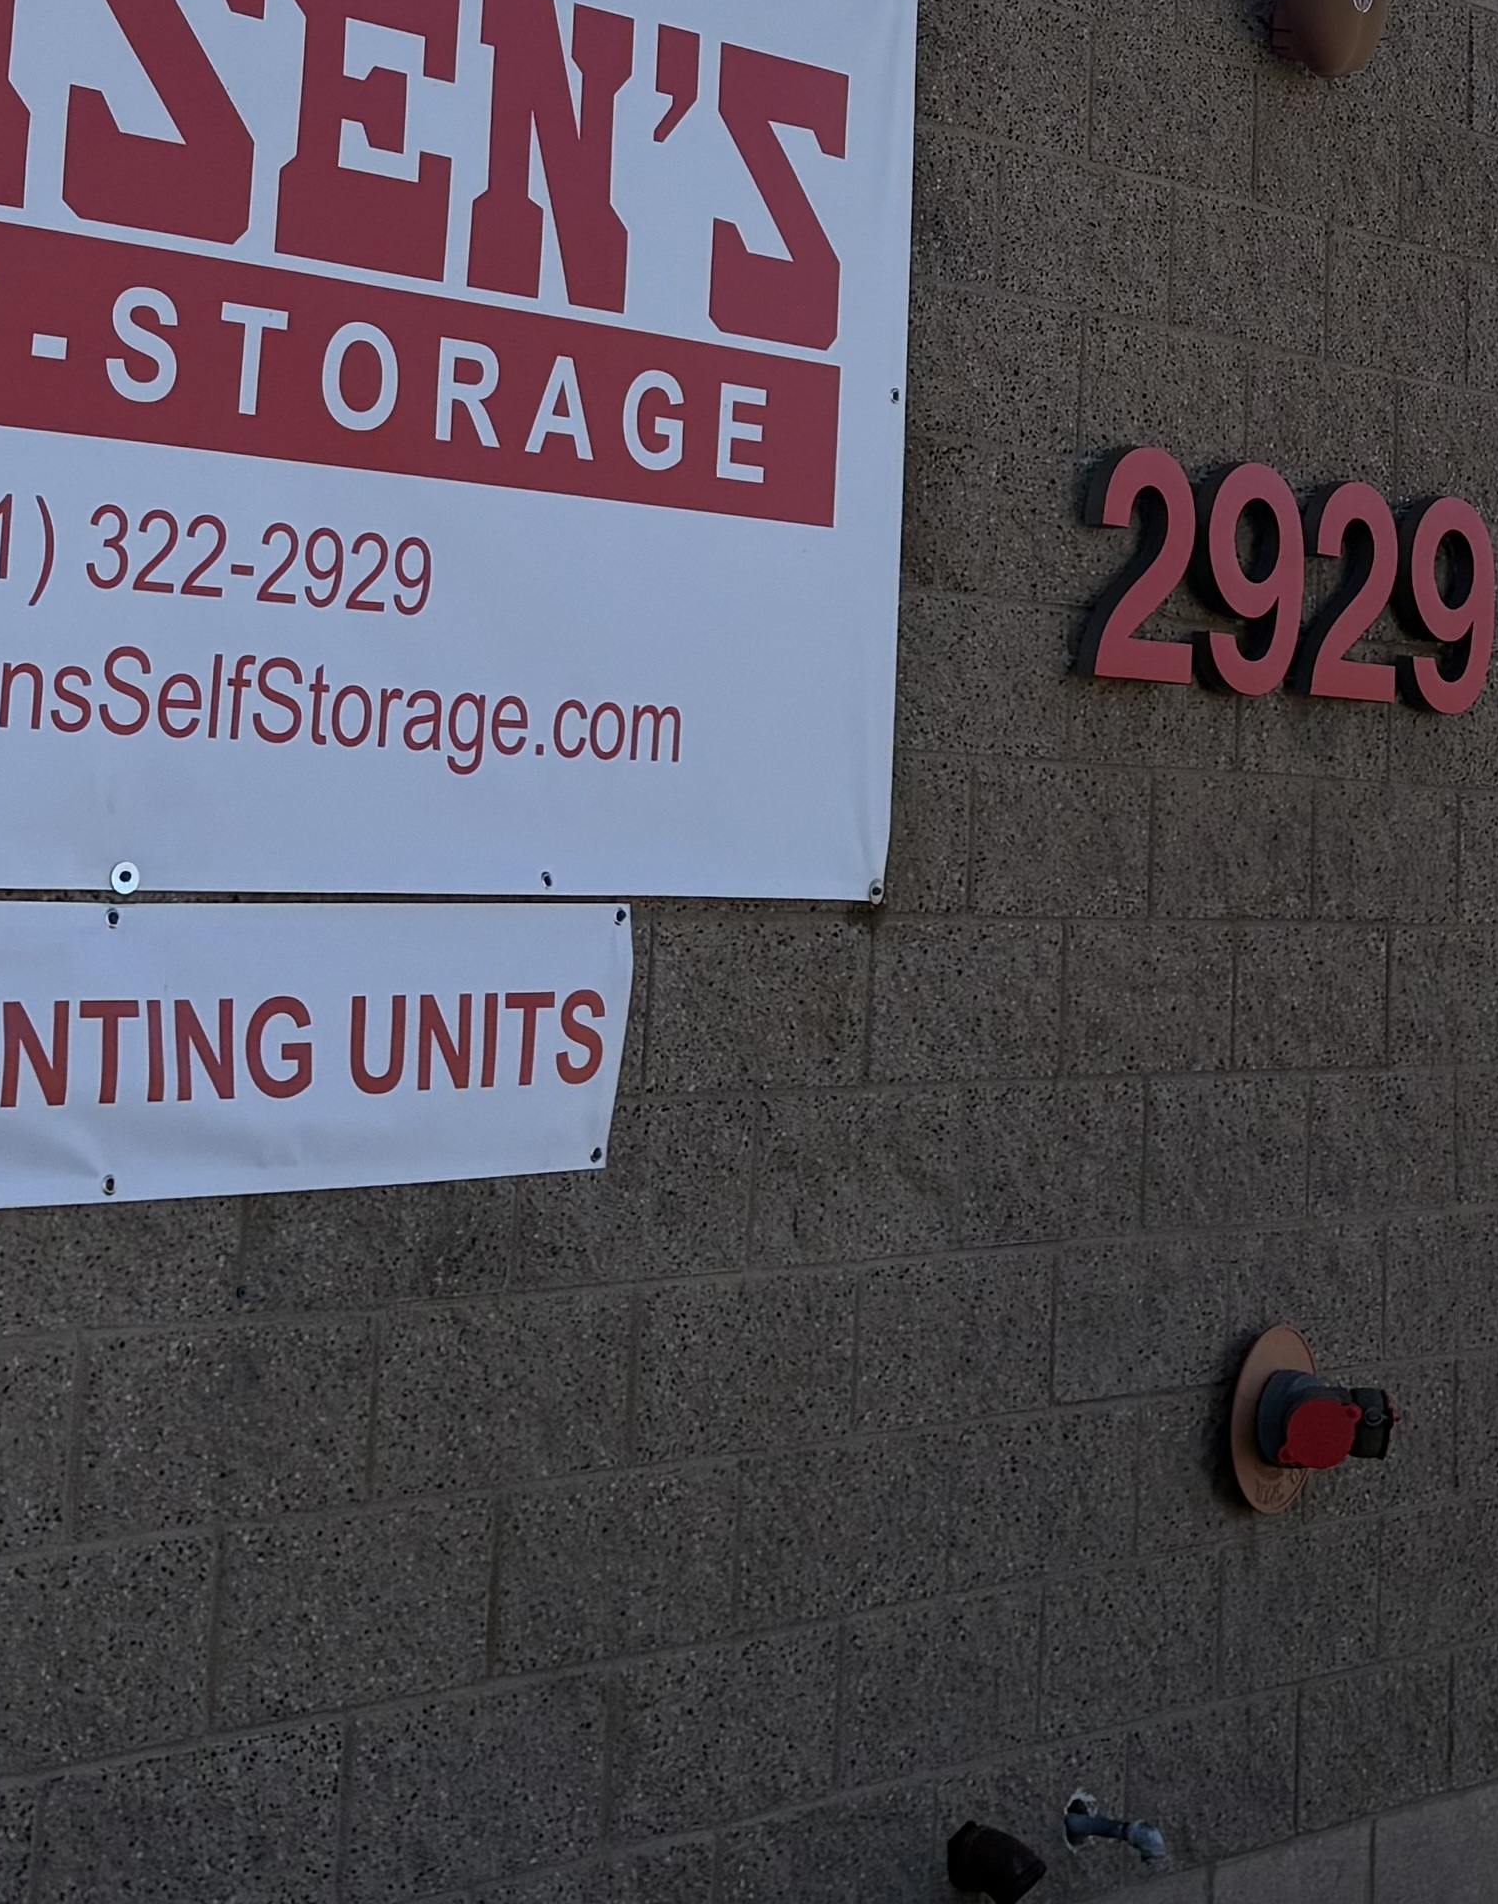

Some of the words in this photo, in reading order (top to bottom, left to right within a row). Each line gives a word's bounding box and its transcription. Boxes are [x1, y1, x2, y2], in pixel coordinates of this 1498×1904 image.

[85, 504, 434, 616] 322-2929
[1093, 446, 1497, 715] 2929
[348, 988, 607, 1095] UNITS
